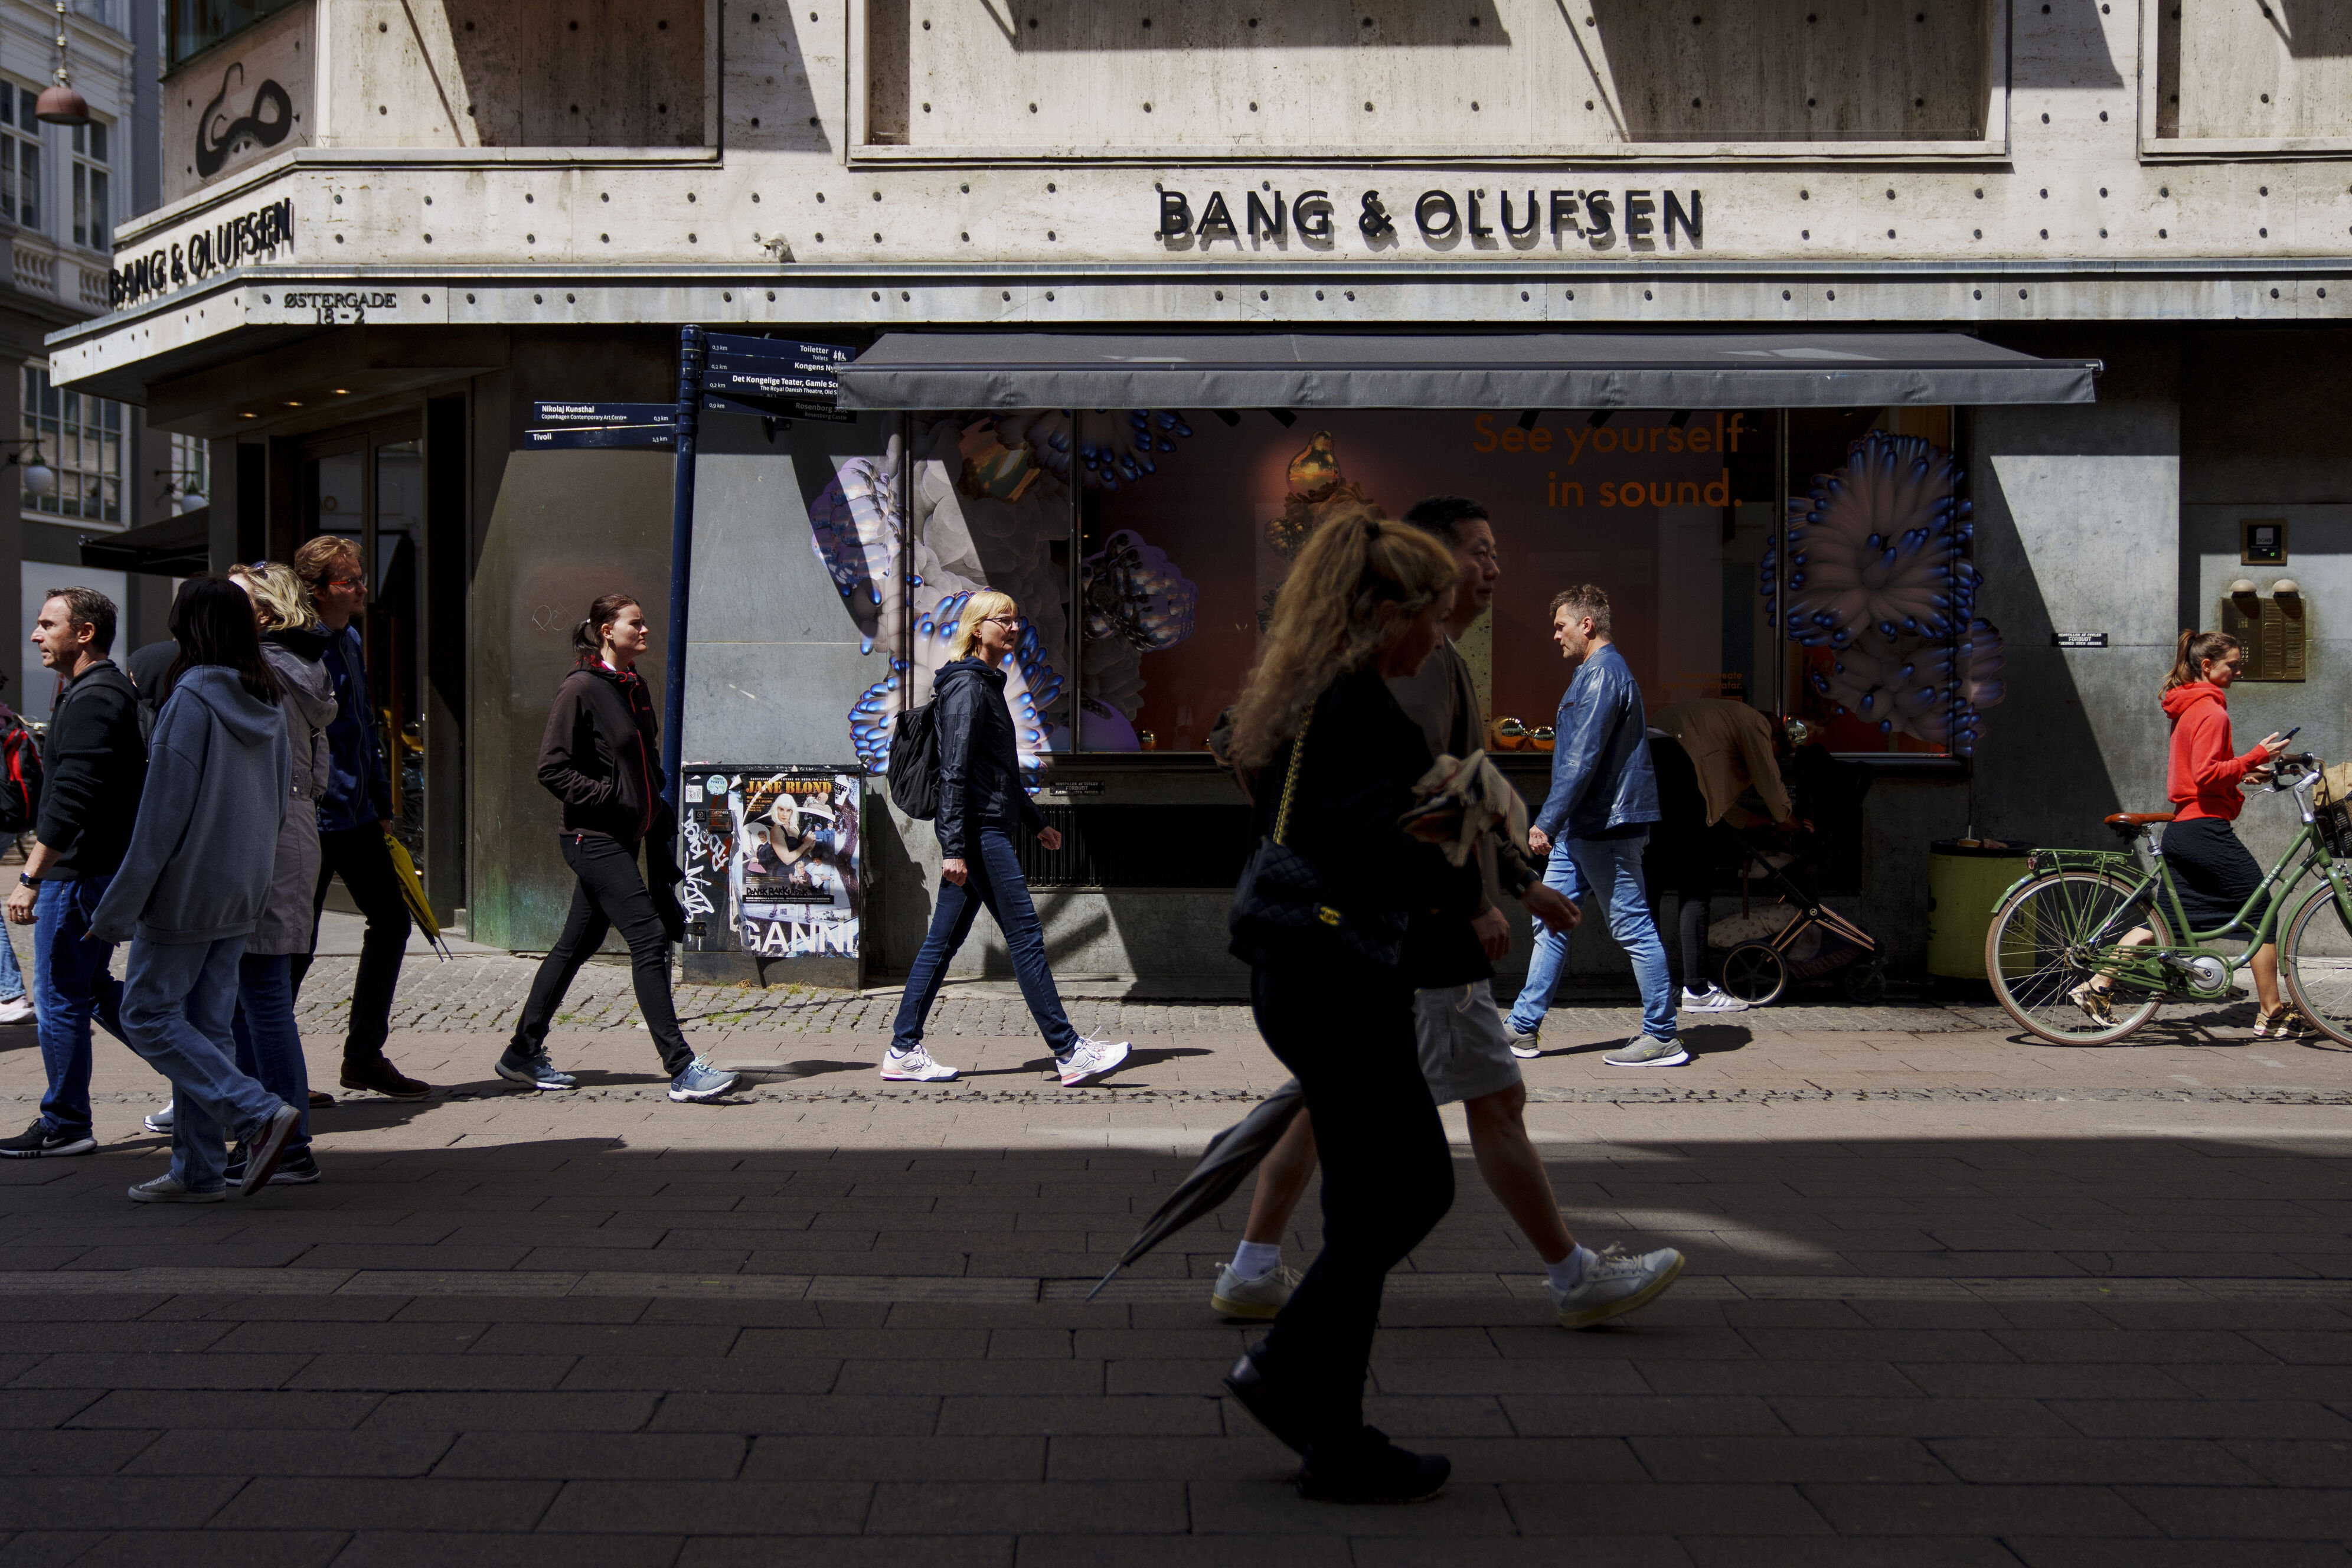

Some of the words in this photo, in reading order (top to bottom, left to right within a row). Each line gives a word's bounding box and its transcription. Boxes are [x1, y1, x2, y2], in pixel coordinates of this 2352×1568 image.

[1159, 190, 1329, 236] BANG
[1358, 190, 1395, 235] &
[1416, 190, 1700, 236] OLUFSEN
[109, 250, 166, 306] BANG
[171, 243, 184, 283] &
[188, 197, 290, 276] OLUFSEN
[284, 292, 397, 308] ØSTERGADE
[316, 307, 335, 324] 18
[800, 345, 829, 354] Toiletter
[795, 362, 824, 371] Kongens
[825, 365, 837, 373] Ny
[746, 376, 780, 386] Kongelige
[781, 378, 804, 387] Teater,
[805, 380, 827, 388] Gamle
[541, 405, 564, 413] Nikolaj
[795, 402, 832, 413] Rosenborg
[804, 411, 831, 420] Rosenborg
[533, 433, 551, 442] Tivoli
[1472, 414, 1553, 453] See
[1564, 412, 1744, 465] yourself
[1549, 471, 1585, 507] in
[1599, 468, 1743, 507] sound.
[1714, 671, 1743, 680] create
[1709, 681, 1743, 690] avatar.
[746, 781, 782, 794] JANE
[785, 781, 832, 794] BLOND
[2261, 864, 2281, 888] EBSEN
[746, 887, 768, 896] DANSK
[768, 886, 808, 896] RAKKERPAK
[739, 920, 854, 953] GANNI
